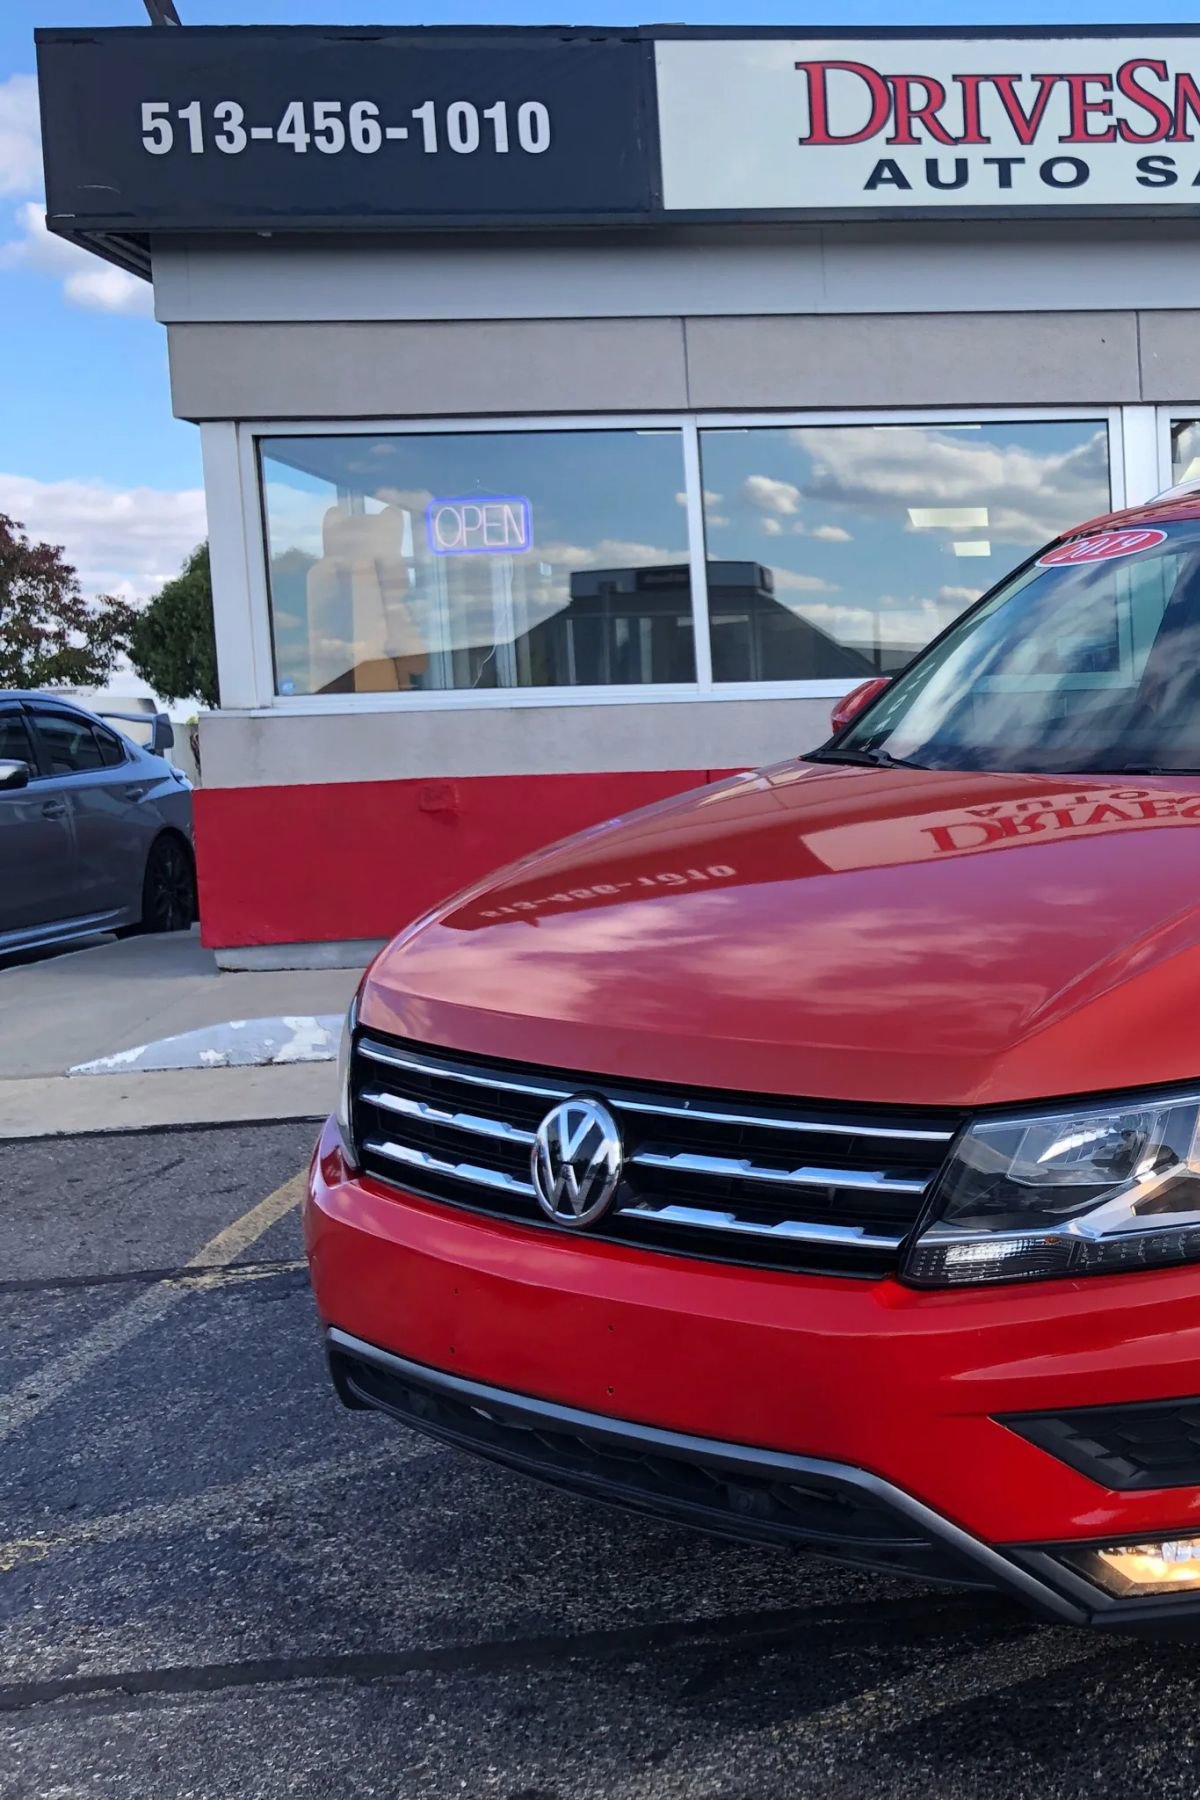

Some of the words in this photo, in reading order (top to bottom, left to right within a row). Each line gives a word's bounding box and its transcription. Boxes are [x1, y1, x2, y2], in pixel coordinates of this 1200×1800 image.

[141, 101, 551, 154] 513-456-1010
[863, 156, 1090, 191] AUTO
[435, 503, 526, 547] OPEN
[1050, 532, 1152, 563] 2019
